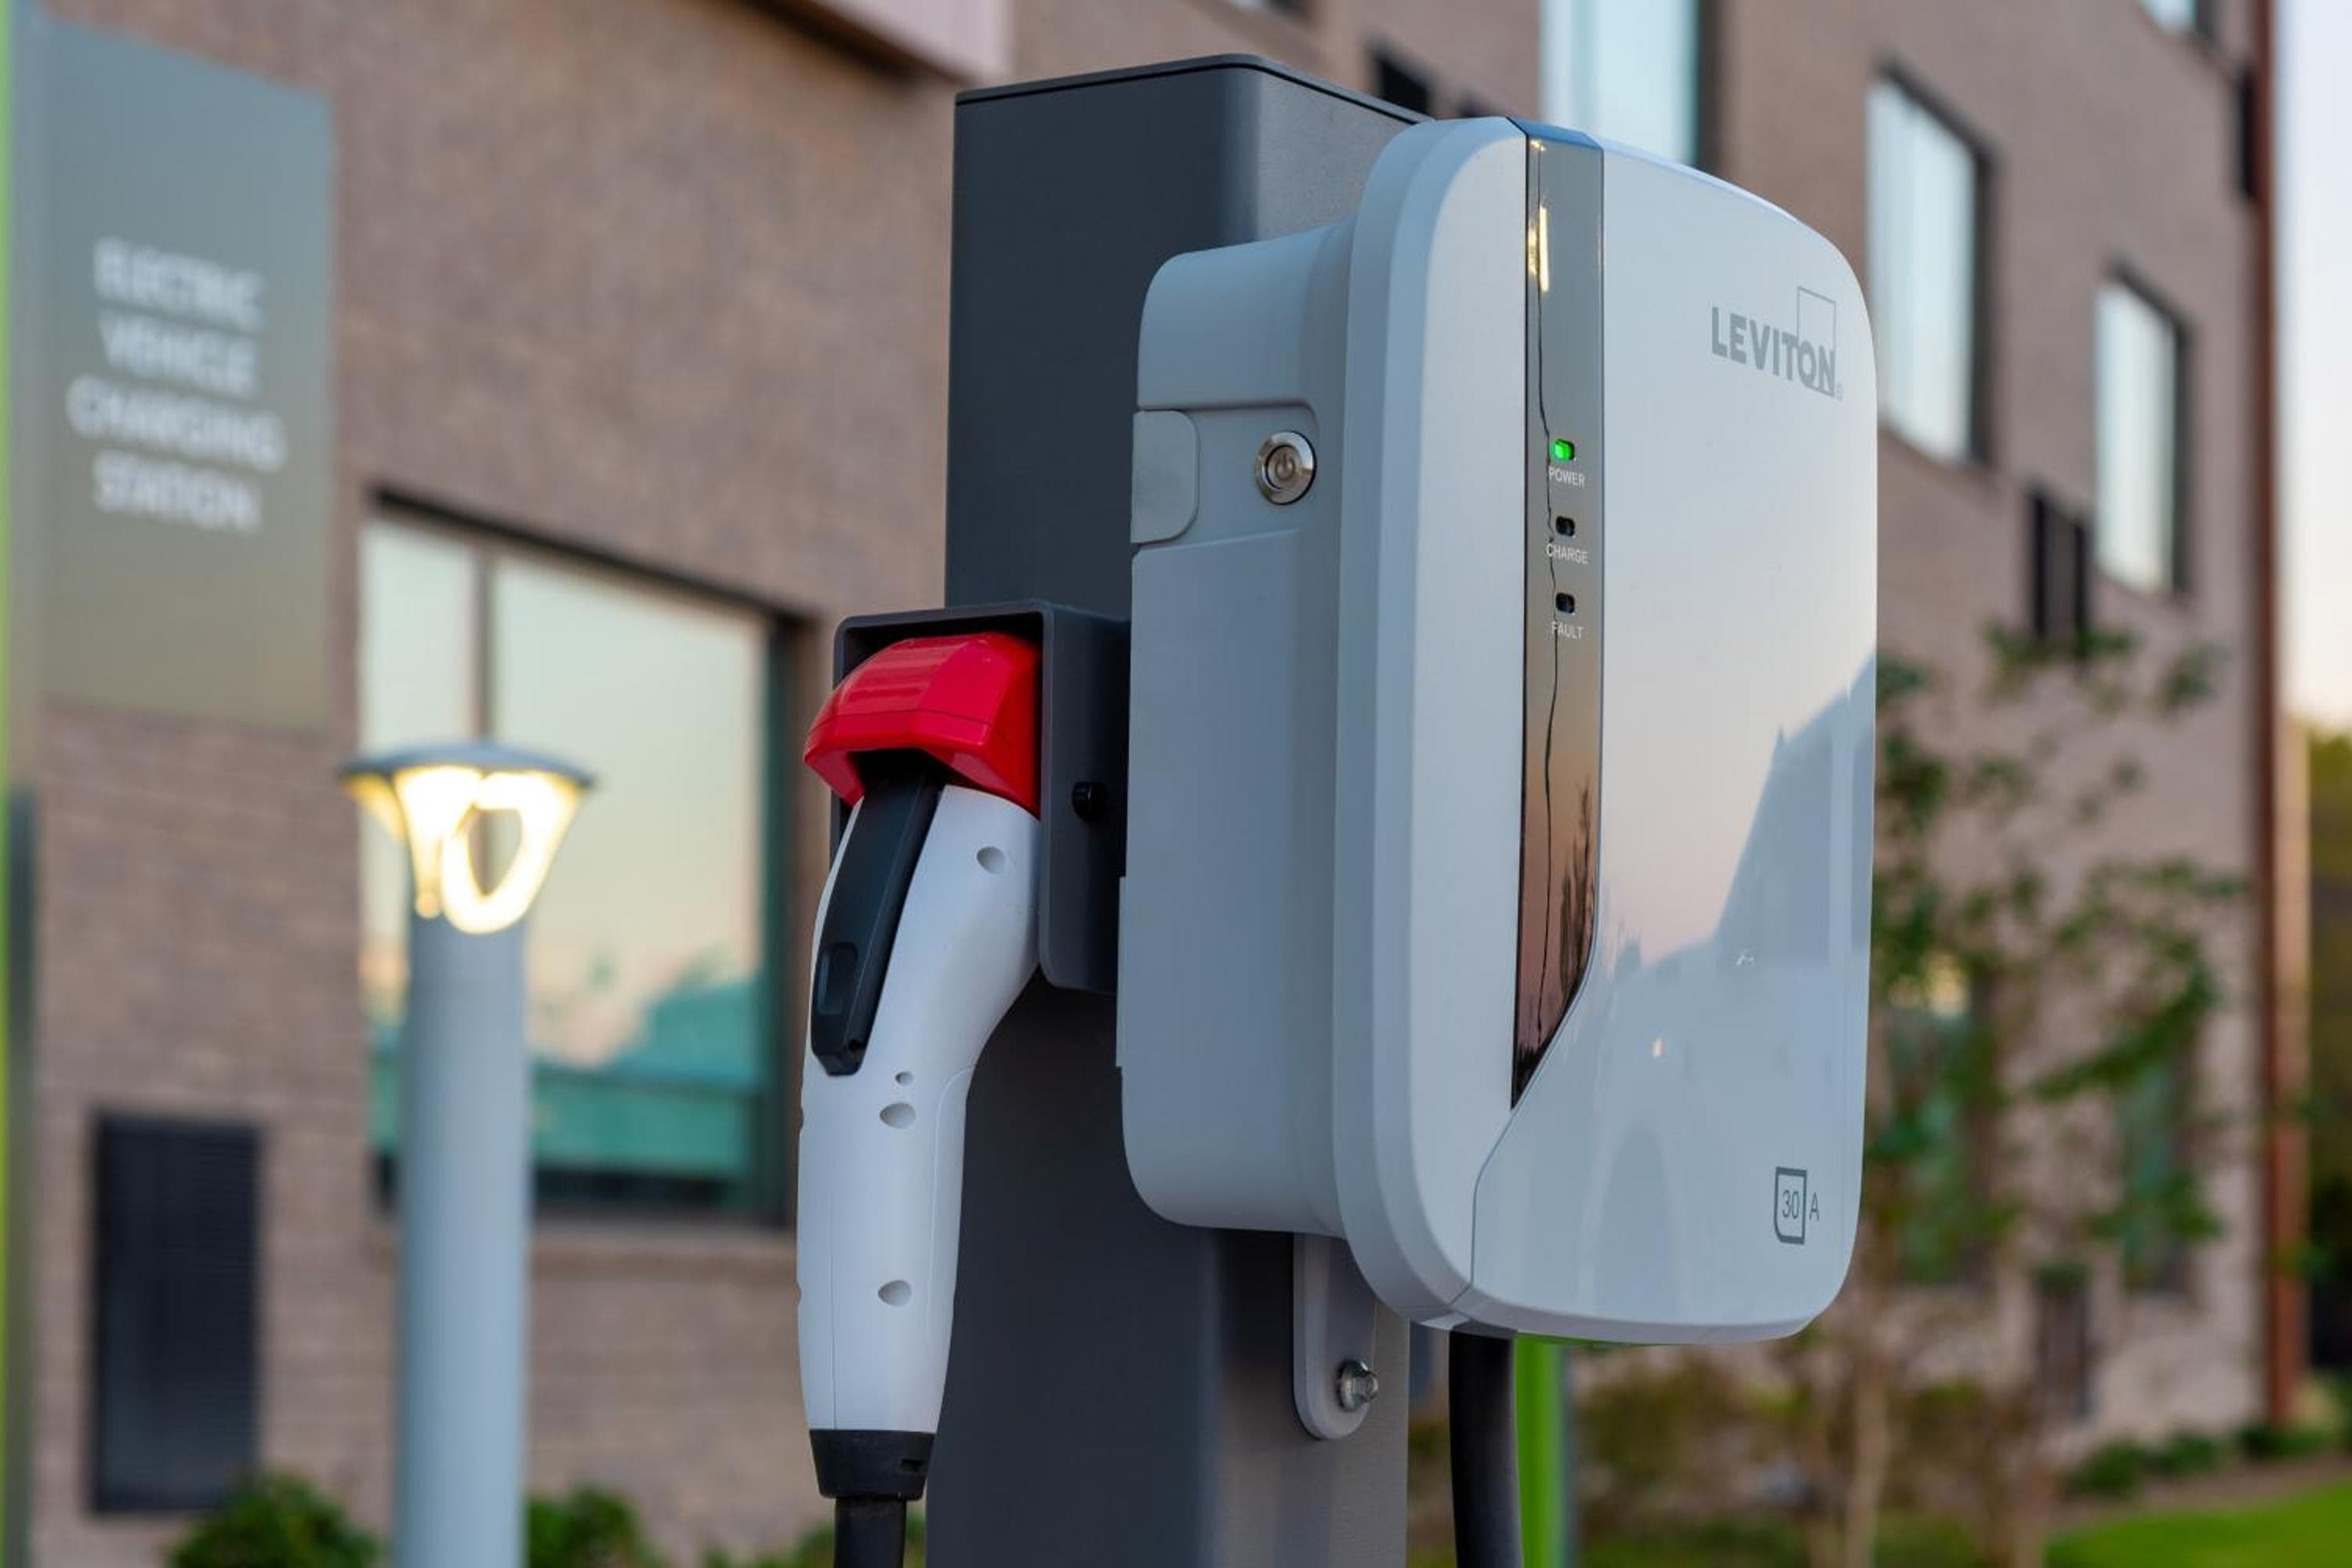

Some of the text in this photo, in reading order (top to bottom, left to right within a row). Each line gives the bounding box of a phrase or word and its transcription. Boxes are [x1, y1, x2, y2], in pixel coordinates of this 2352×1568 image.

[97, 309, 260, 397] VEHICLE
[1711, 307, 1835, 398] LEVITON
[66, 373, 288, 472] CHARGING
[93, 449, 262, 535] STATION
[1548, 466, 1585, 488] POWER
[1546, 543, 1588, 564] CHARGE
[1552, 621, 1583, 639] FAULT
[1782, 1189, 1820, 1221] 30 A
